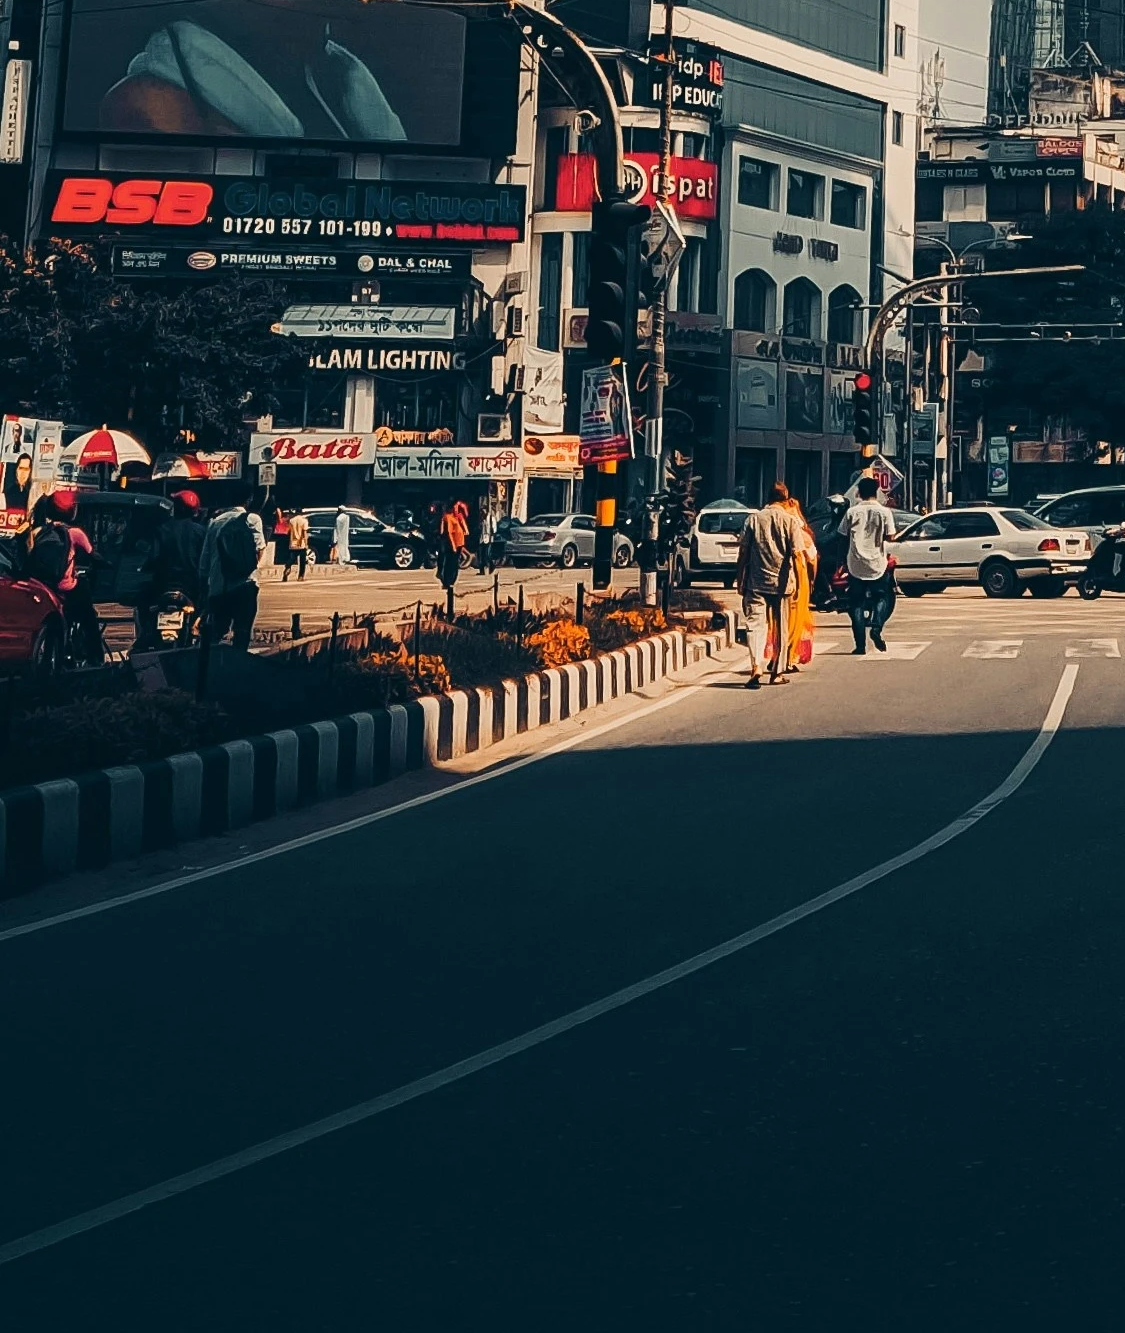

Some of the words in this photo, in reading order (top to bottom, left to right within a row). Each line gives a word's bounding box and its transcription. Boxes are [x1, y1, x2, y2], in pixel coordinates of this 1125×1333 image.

[677, 54, 704, 81] idp
[51, 178, 214, 225] BSB
[224, 182, 357, 218] Global
[364, 185, 519, 223] Network
[223, 217, 275, 234] 01720
[281, 218, 313, 235] 557
[318, 219, 382, 237] 101-199
[221, 253, 282, 265] PREMIUM
[285, 254, 337, 266] SWEETS
[378, 257, 401, 268] DAL
[405, 258, 415, 268] &
[419, 258, 453, 269] CHAL
[368, 349, 467, 370] LIGHTING
[270, 437, 363, 460] Bata
